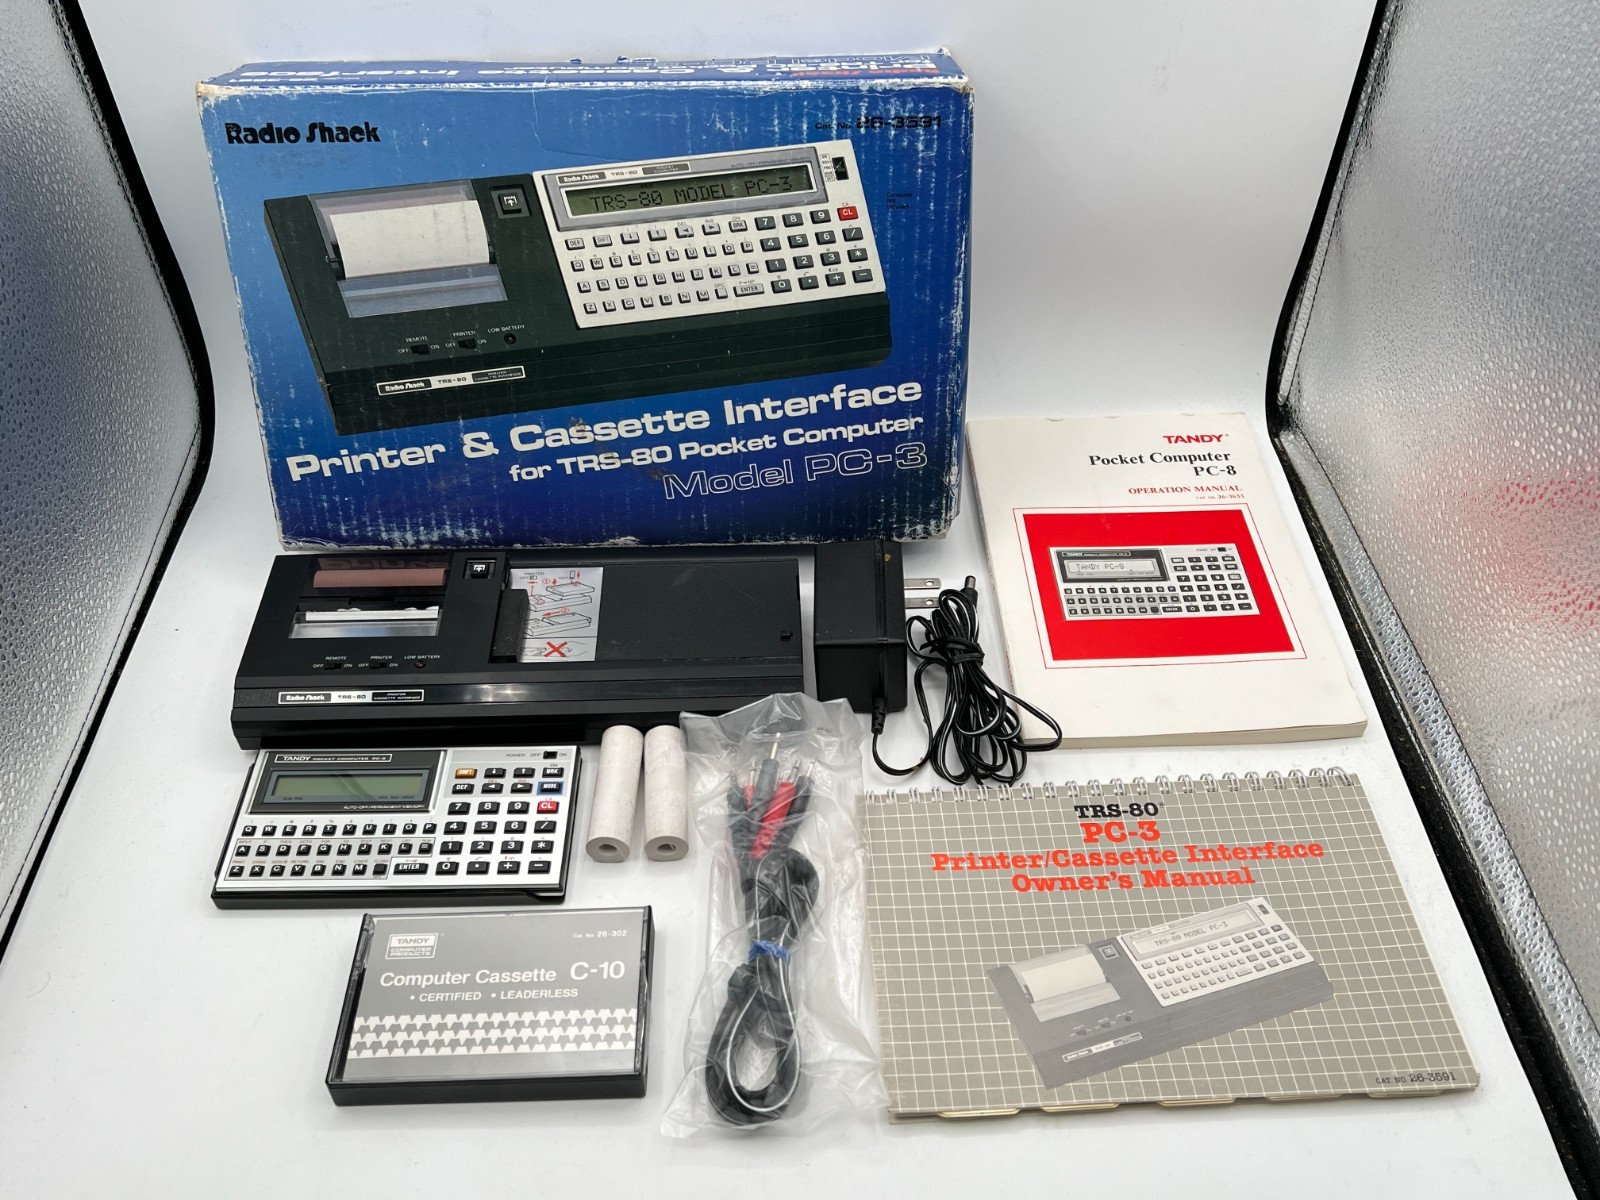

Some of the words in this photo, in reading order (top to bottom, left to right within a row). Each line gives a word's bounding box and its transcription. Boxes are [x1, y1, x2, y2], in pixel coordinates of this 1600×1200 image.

[856, 115, 942, 130] 26-3591
[225, 122, 300, 144] Radio
[306, 122, 380, 143] Shack
[590, 190, 662, 212] TRS-80
[674, 184, 734, 204] MODEL
[744, 176, 792, 196] PC-3
[286, 442, 446, 482] Printer
[462, 432, 500, 458] &
[510, 408, 710, 452] Cassette
[724, 382, 922, 425] Interface
[1163, 434, 1224, 444] TANDY
[509, 464, 552, 482] for
[556, 445, 672, 474] TRS-80
[679, 434, 777, 460] Pocket
[783, 414, 924, 445] Computer
[1088, 454, 1145, 466] Pocket
[1150, 451, 1231, 464] Computer
[663, 458, 794, 500] Model
[804, 442, 928, 482] PC-3
[1193, 465, 1238, 476] PC-8
[1128, 486, 1192, 494] OPERATION
[1074, 802, 1158, 818] TRS-80
[1080, 820, 1161, 844] PC-3
[931, 848, 1178, 872] Printer/Cassette
[1185, 840, 1324, 863] Interface
[1012, 870, 1133, 892] Owner's
[1140, 866, 1256, 888] Manual
[596, 930, 628, 938] 26-302
[380, 970, 471, 989] Computer
[476, 968, 556, 984] Cassette
[570, 960, 626, 980] C-10
[419, 992, 482, 1002] CERTIFIED
[500, 988, 578, 1000] LEADERLESS
[1409, 1072, 1457, 1082] 26-3591
